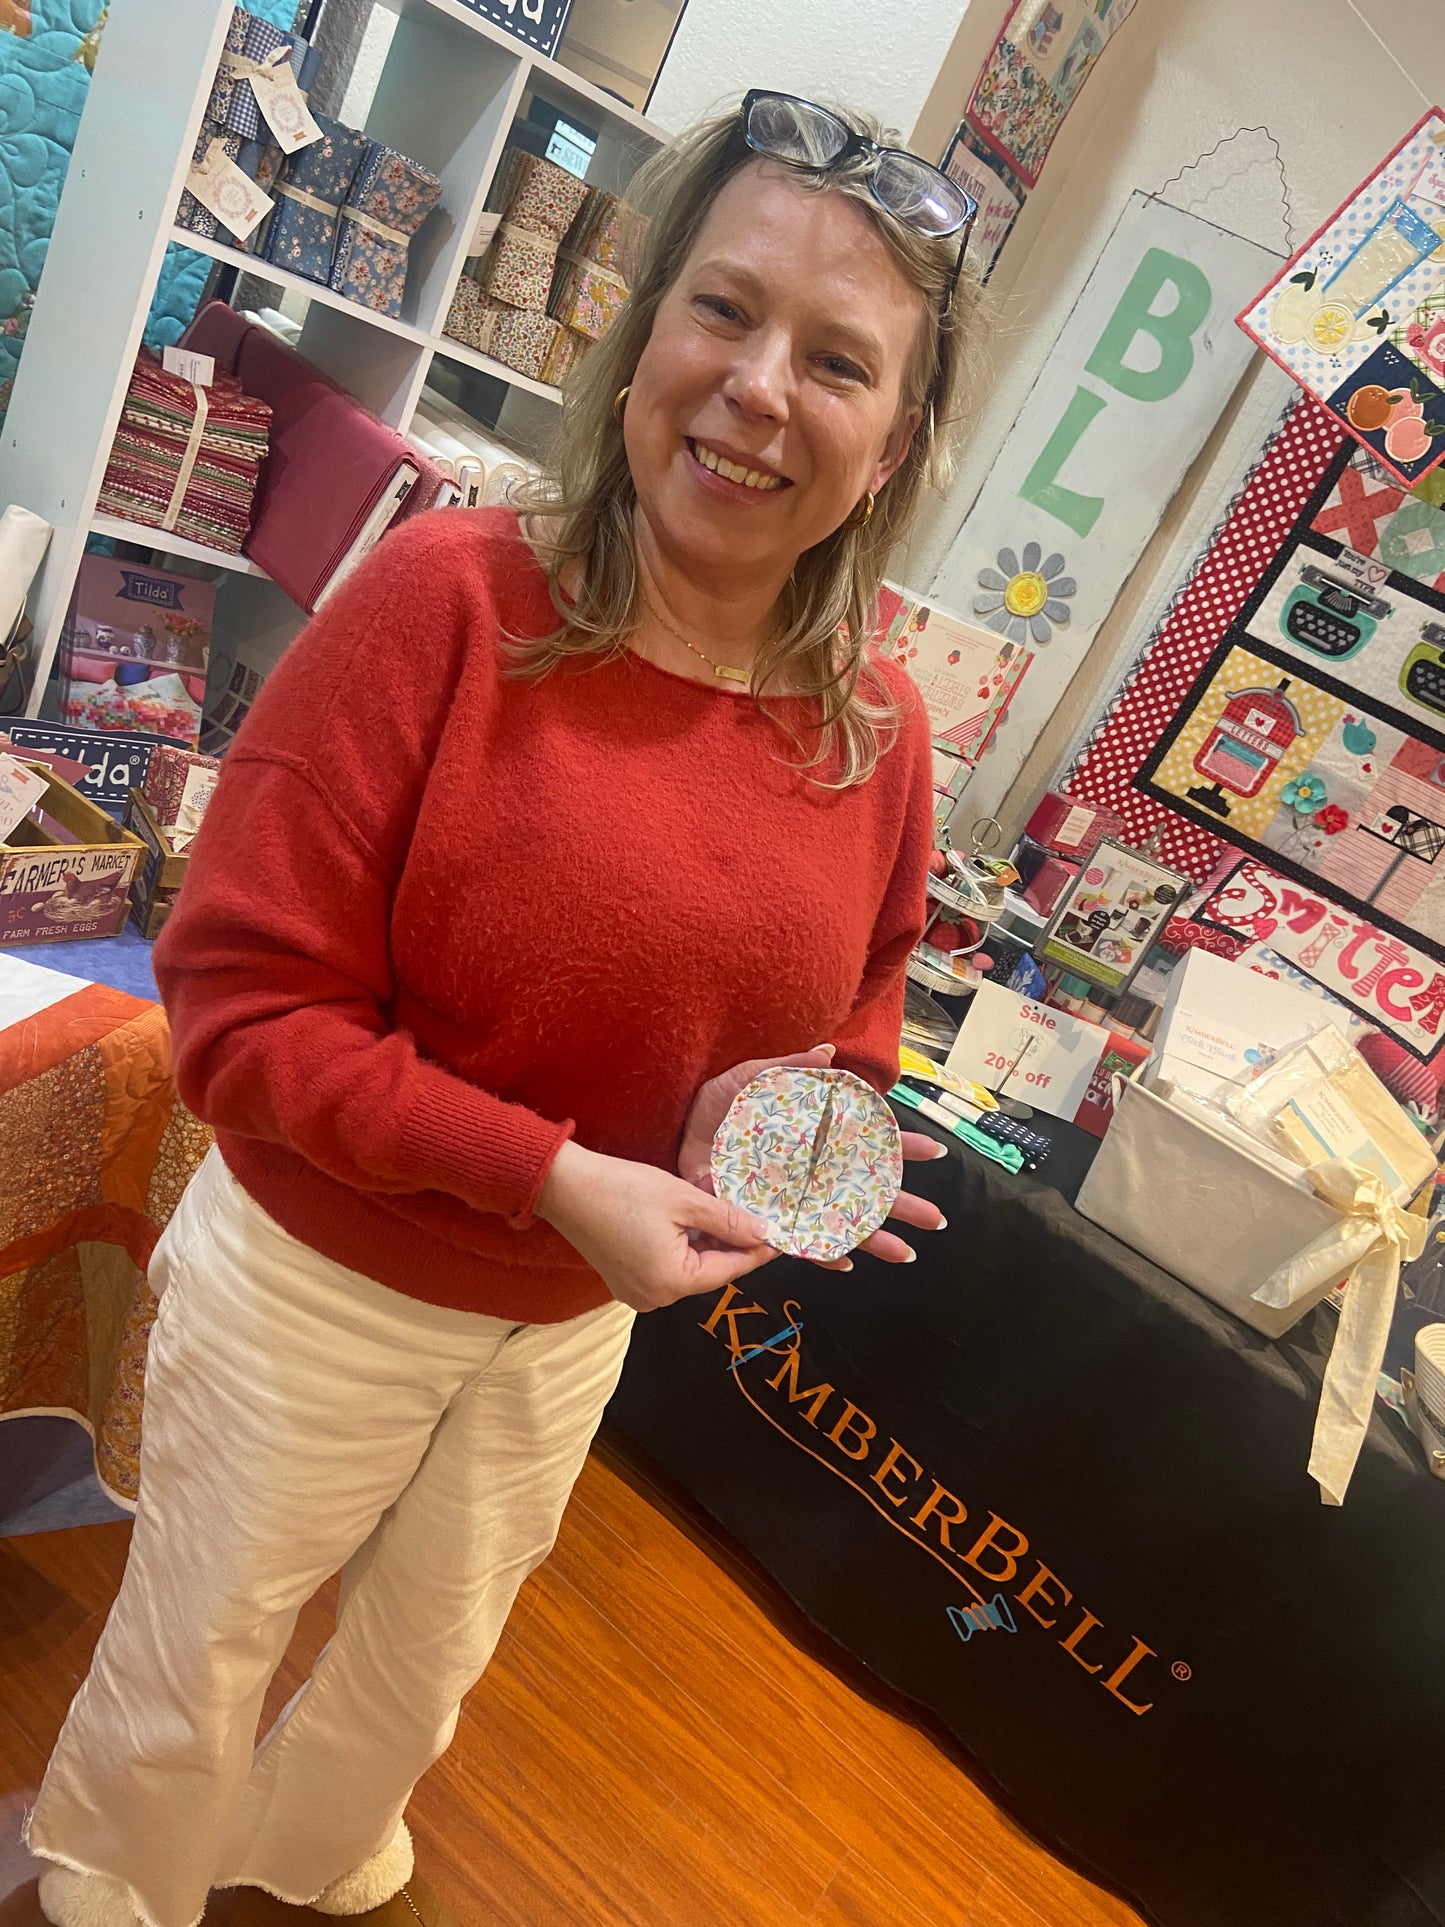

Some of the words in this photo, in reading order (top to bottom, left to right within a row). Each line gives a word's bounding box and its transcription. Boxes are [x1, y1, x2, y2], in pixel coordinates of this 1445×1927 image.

[135, 582, 168, 600] Tilda
[1230, 725, 1269, 751] LETTERS
[91, 854, 132, 873] MARKET
[3, 929, 31, 940] FARM
[36, 925, 68, 937] FRESH
[72, 922, 99, 933] EGGS
[1019, 1004, 1057, 1030] Sale
[983, 1052, 1020, 1078] 20%
[1025, 1072, 1052, 1088] off
